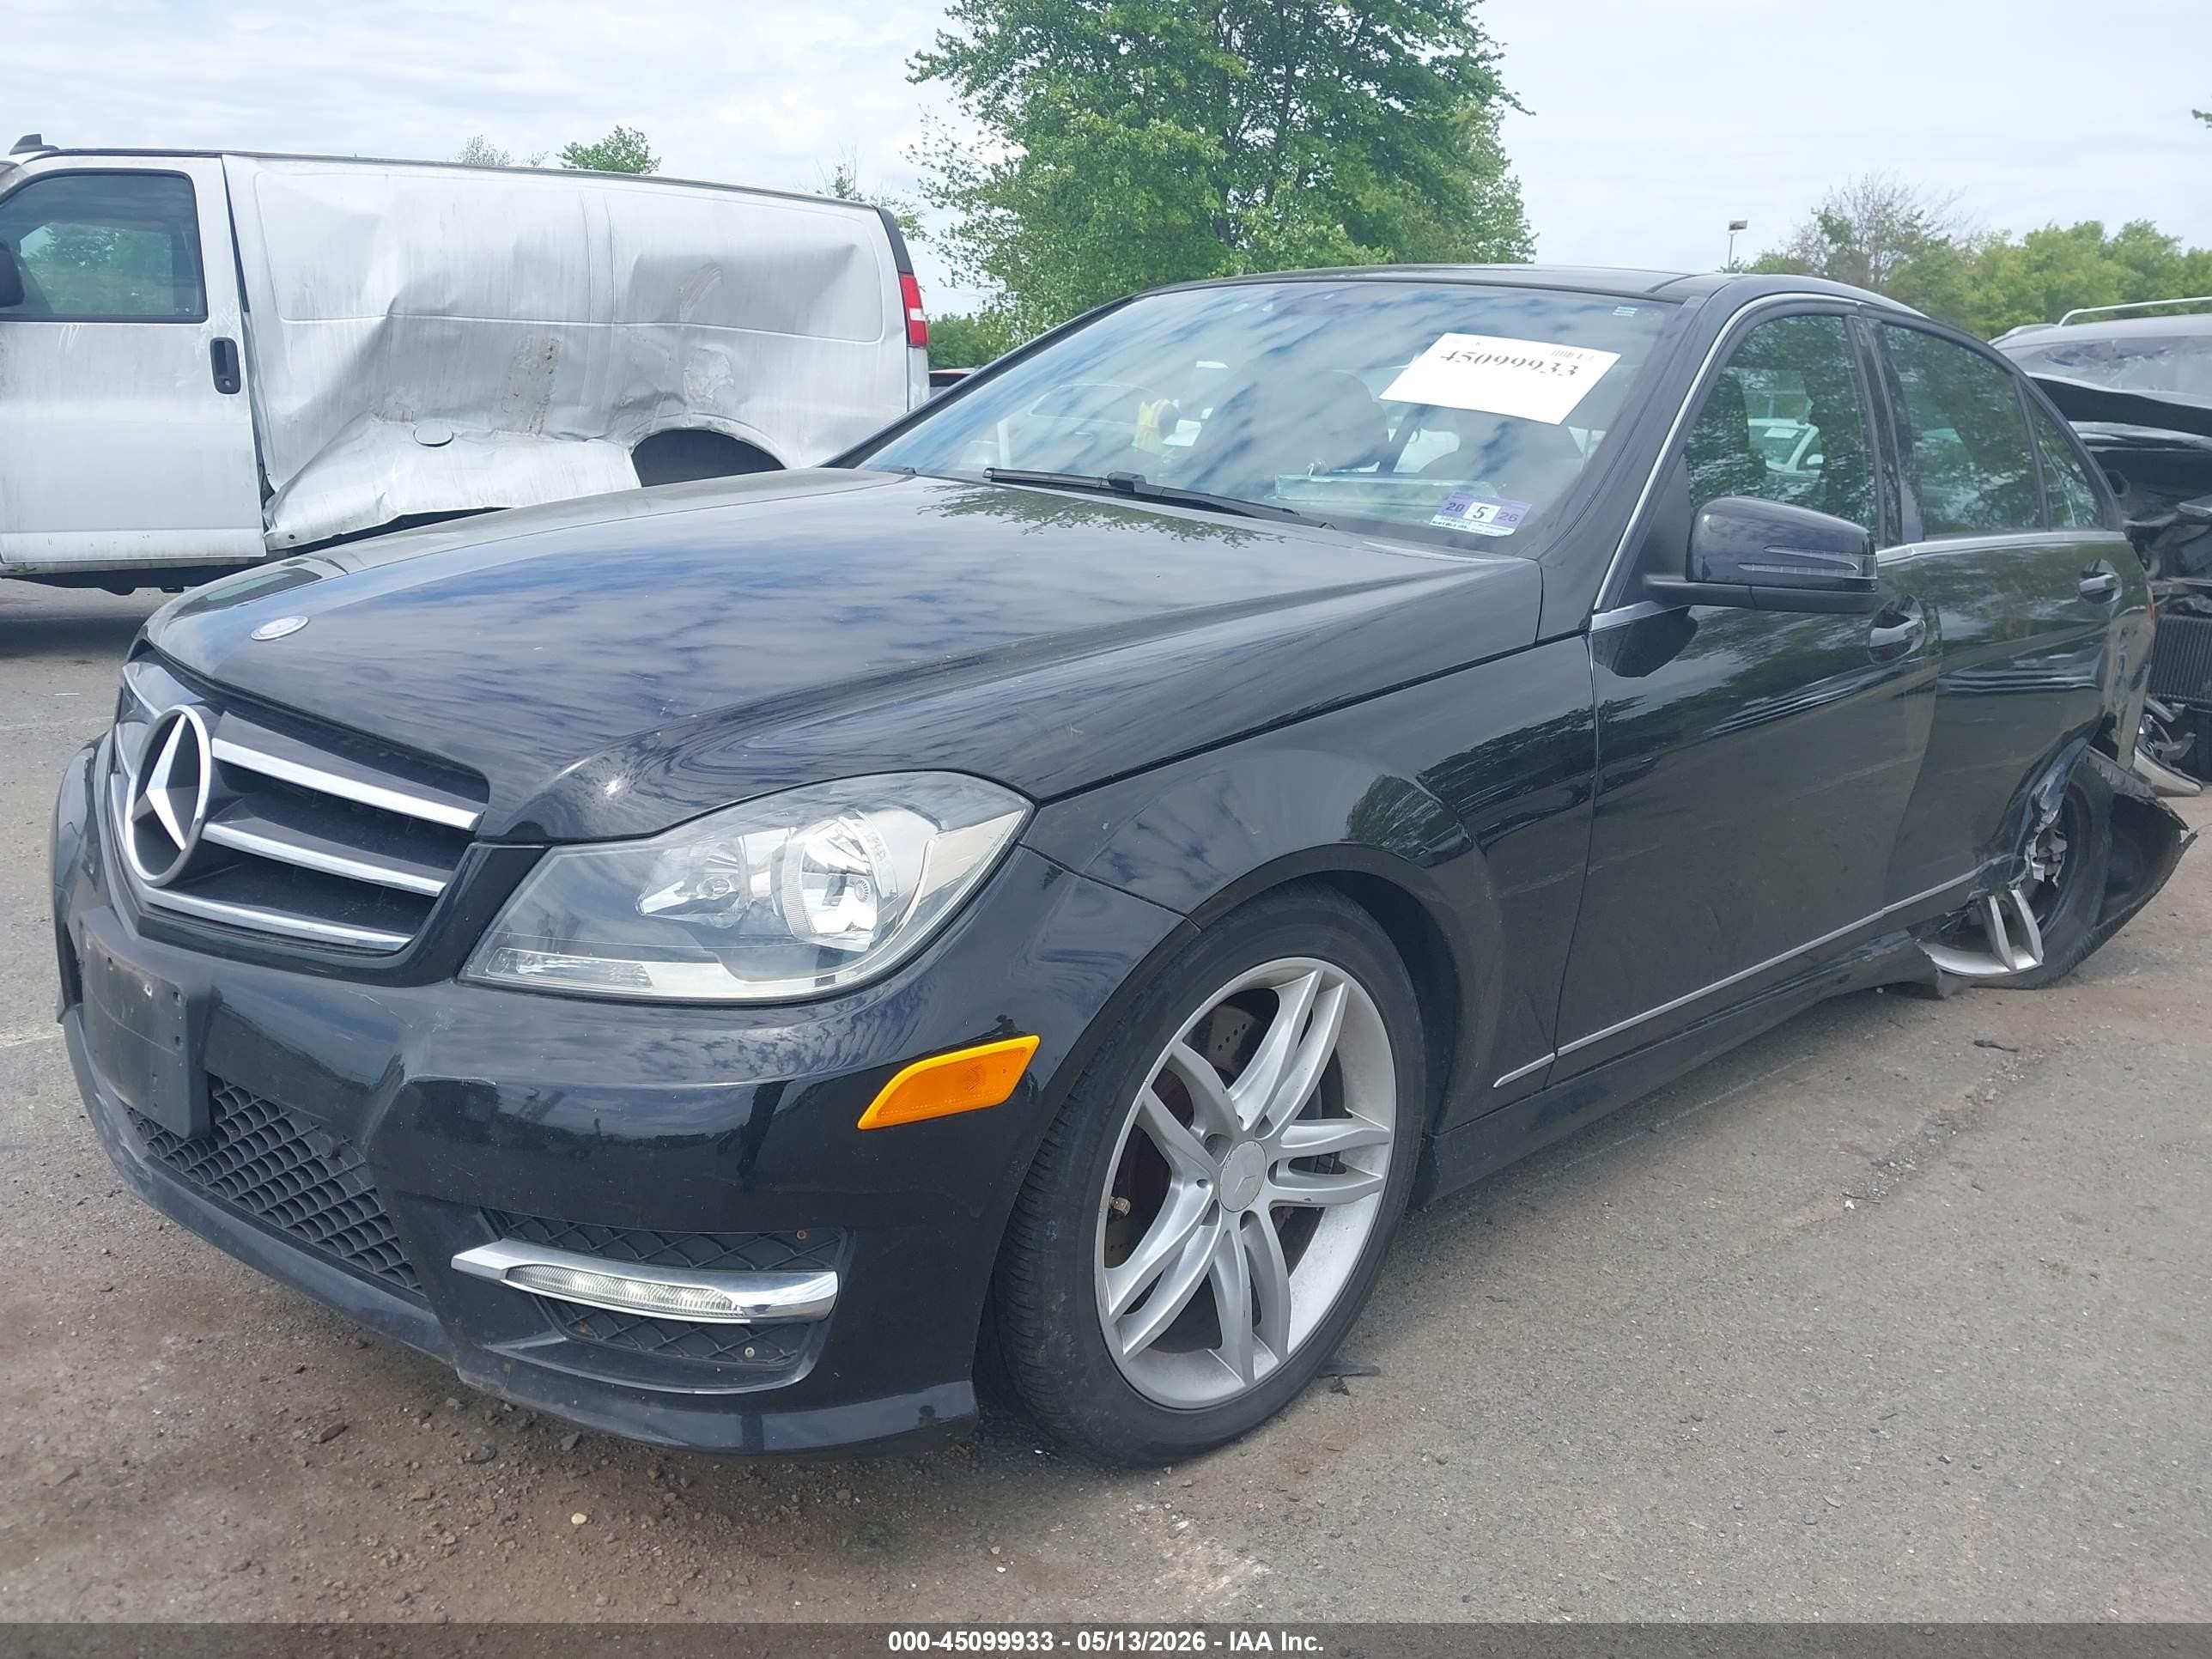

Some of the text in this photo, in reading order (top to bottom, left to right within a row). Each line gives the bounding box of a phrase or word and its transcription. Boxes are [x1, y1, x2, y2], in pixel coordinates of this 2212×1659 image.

[1439, 349, 1579, 377] 45099933
[1446, 502, 1519, 522] 20 5 26
